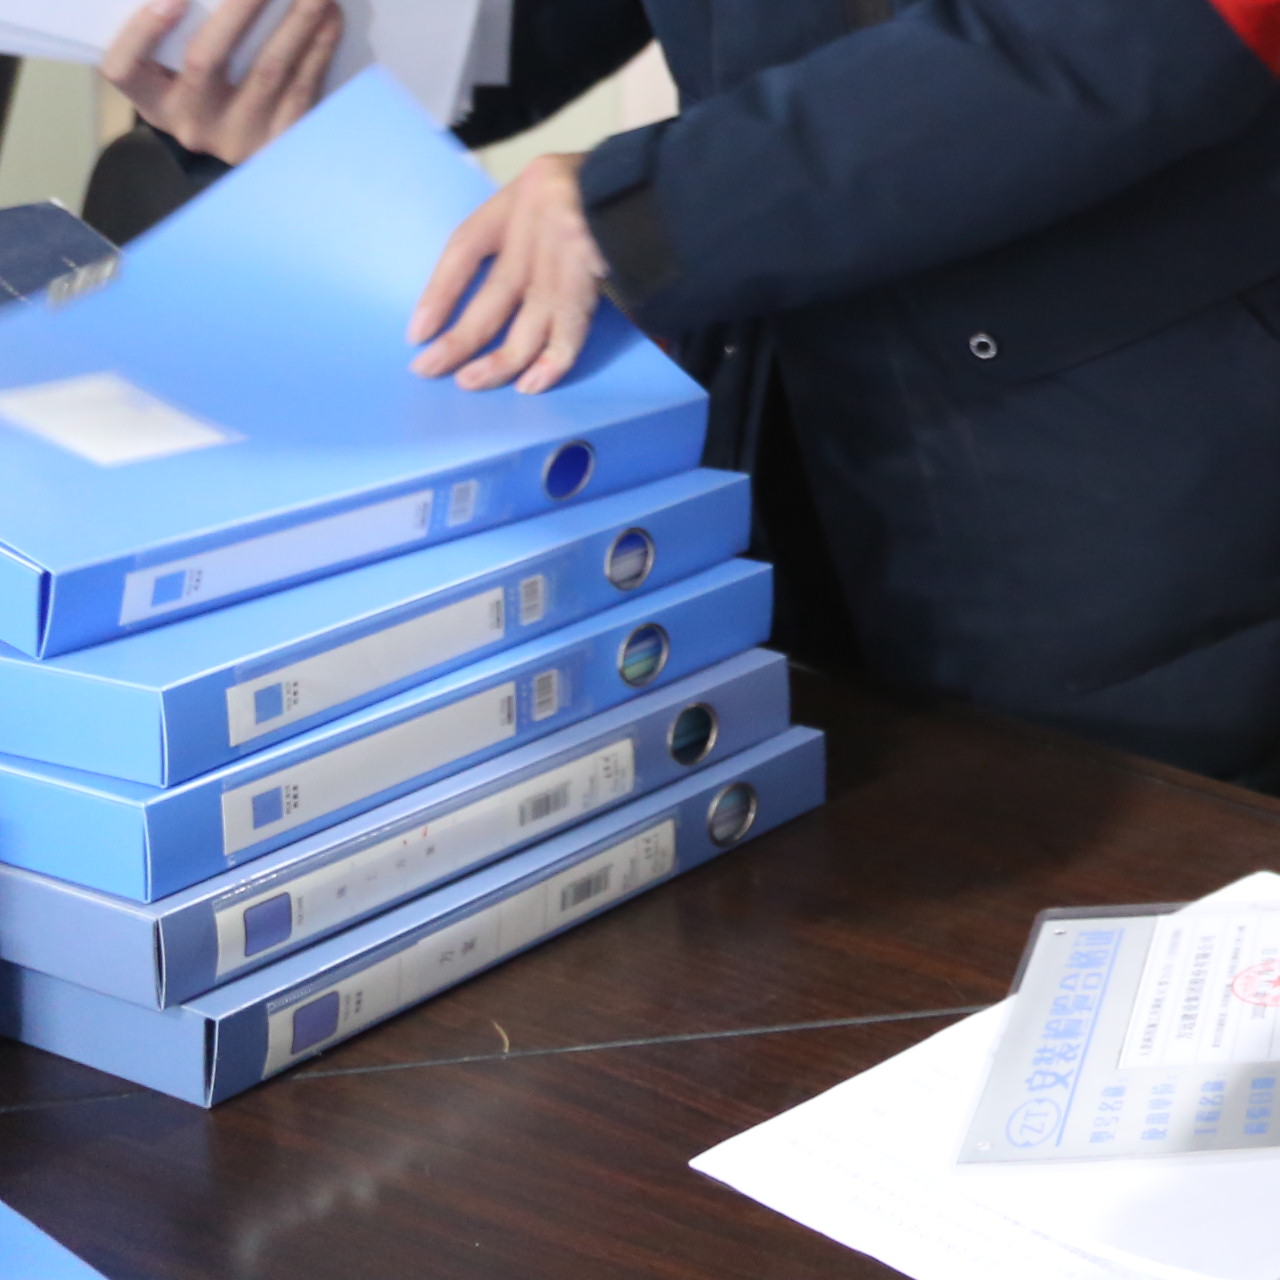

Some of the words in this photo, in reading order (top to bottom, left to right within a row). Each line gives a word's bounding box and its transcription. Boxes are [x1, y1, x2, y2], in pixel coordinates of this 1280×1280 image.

[1024, 928, 1116, 1091] 安装检验合格证
